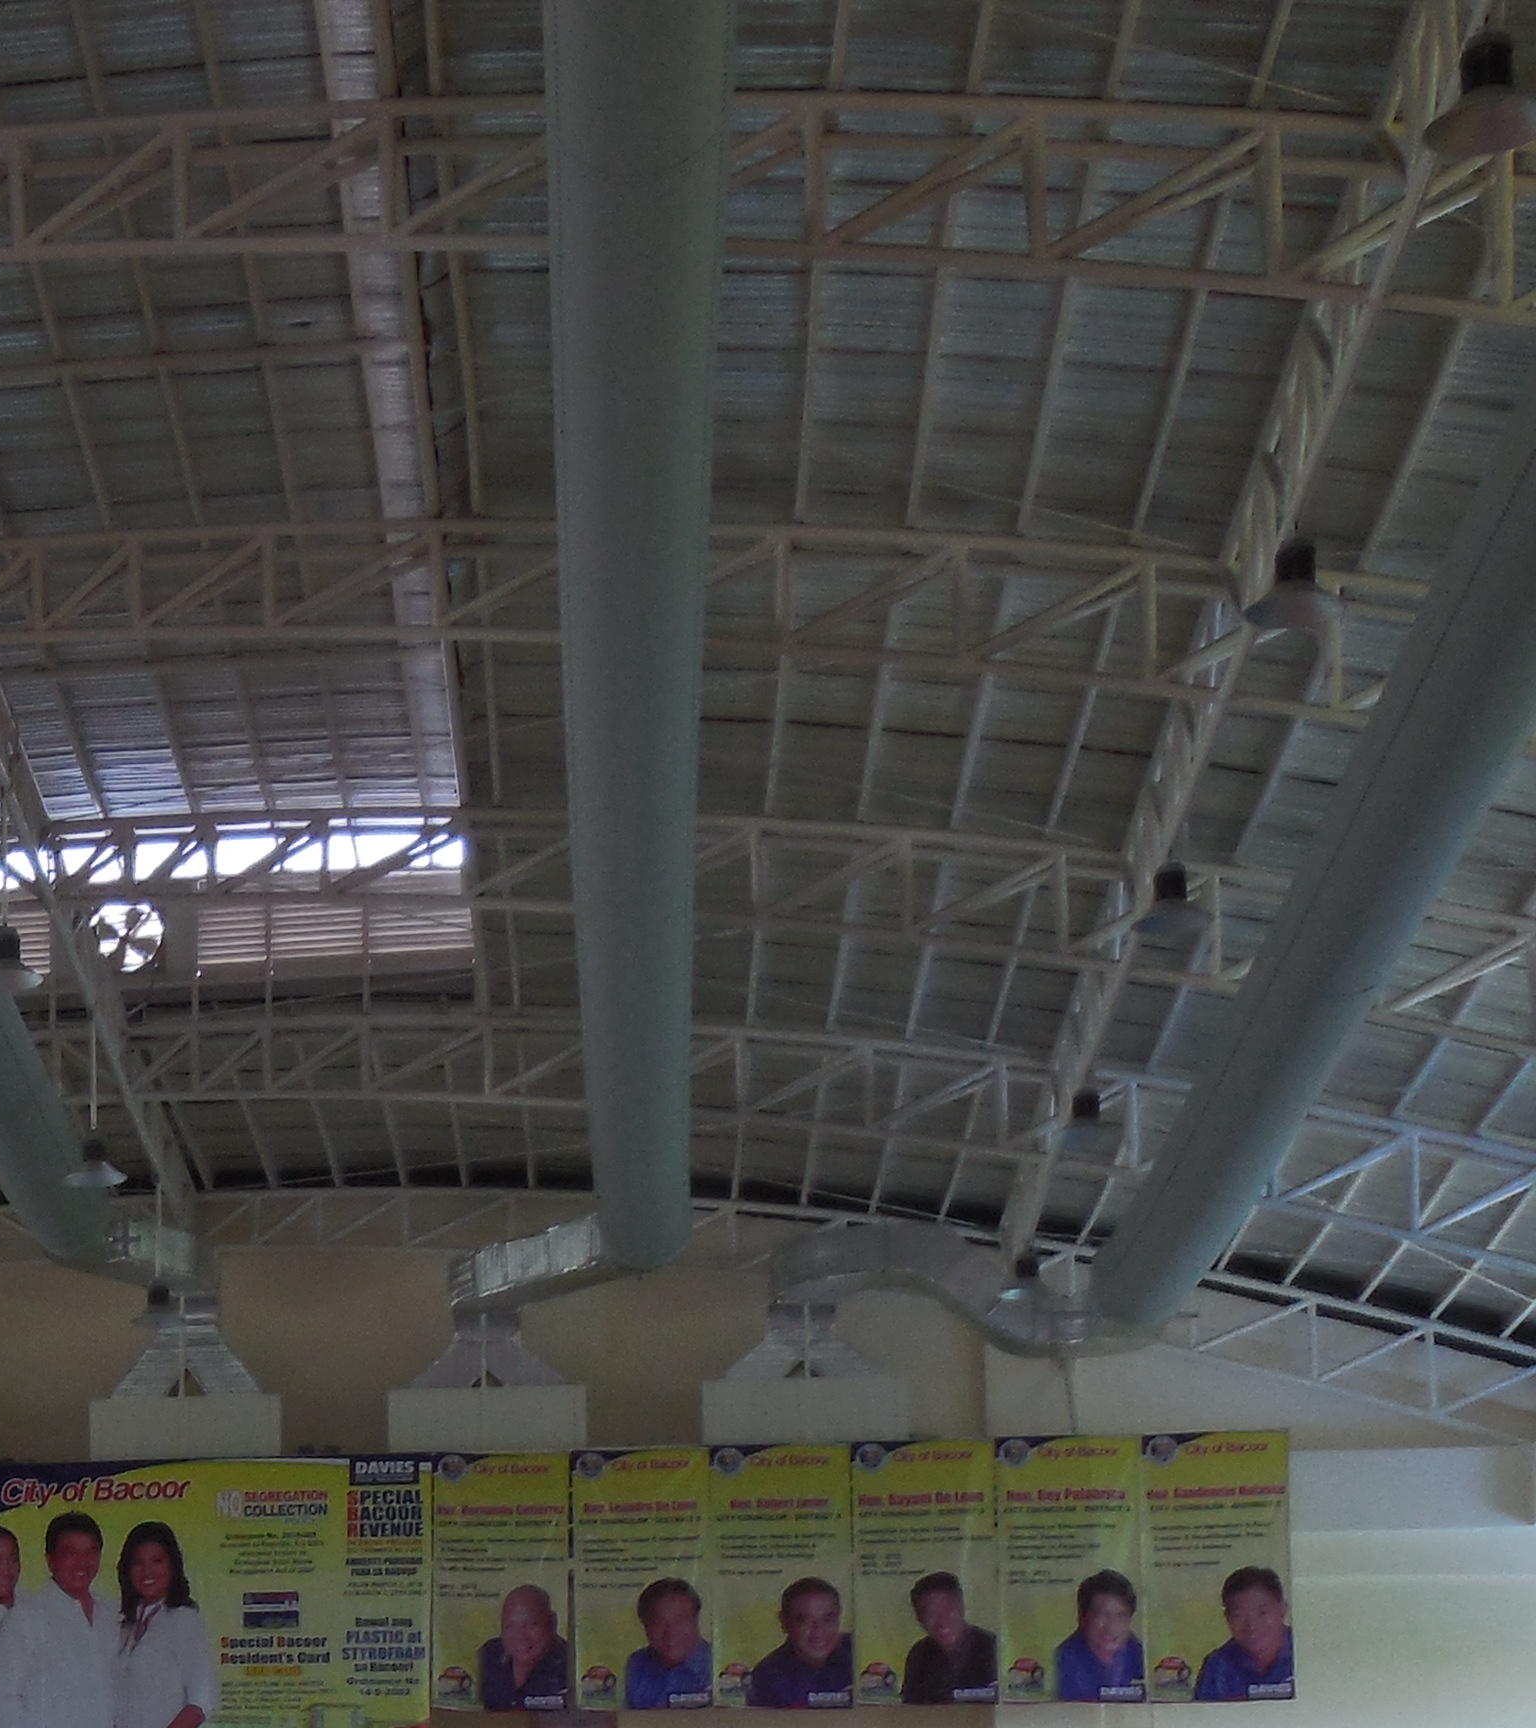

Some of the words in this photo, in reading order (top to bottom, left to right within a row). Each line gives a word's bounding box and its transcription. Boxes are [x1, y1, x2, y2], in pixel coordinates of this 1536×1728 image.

[355, 1461, 415, 1474] DAVIES
[1, 1478, 56, 1508] City
[62, 1477, 90, 1502] of
[92, 1476, 192, 1502] Bacoor
[347, 1490, 424, 1505] SPECIAL
[244, 1503, 328, 1517] COLLECTION
[347, 1506, 423, 1521] BACOOR
[347, 1522, 425, 1538] REVENUE
[220, 1636, 274, 1649] Special
[277, 1636, 327, 1648] Bacoor
[346, 1630, 403, 1644] PLASTIC
[297, 1651, 331, 1664] Card
